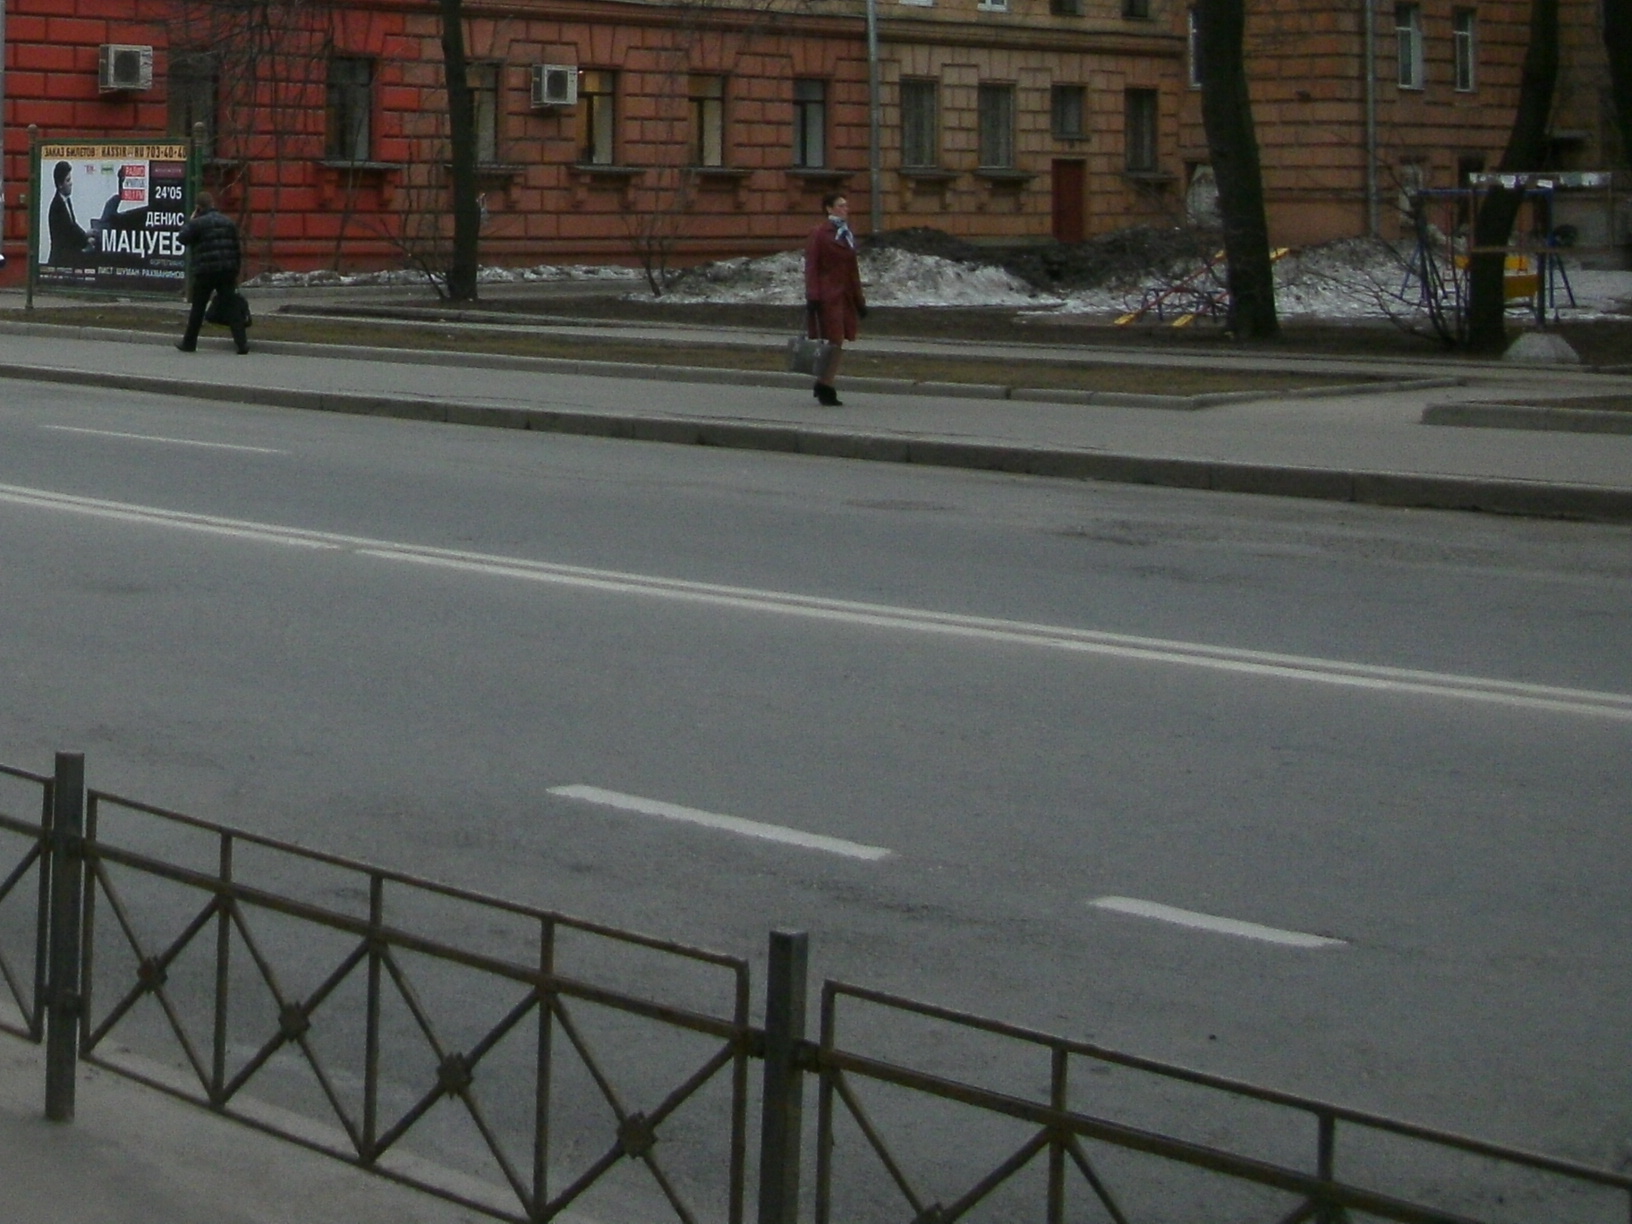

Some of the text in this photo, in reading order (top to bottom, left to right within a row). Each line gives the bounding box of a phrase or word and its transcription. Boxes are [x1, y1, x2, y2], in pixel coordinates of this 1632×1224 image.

[44, 146, 96, 158] ЗАКАЗ БИЛЕТОВ
[145, 211, 185, 227] ДЕНИС
[101, 229, 186, 258] МАЦУЕВ
[97, 266, 113, 275] ЛИСТ
[116, 267, 140, 276] ШУМАН
[141, 268, 185, 279] РАХМАНИНОВ
